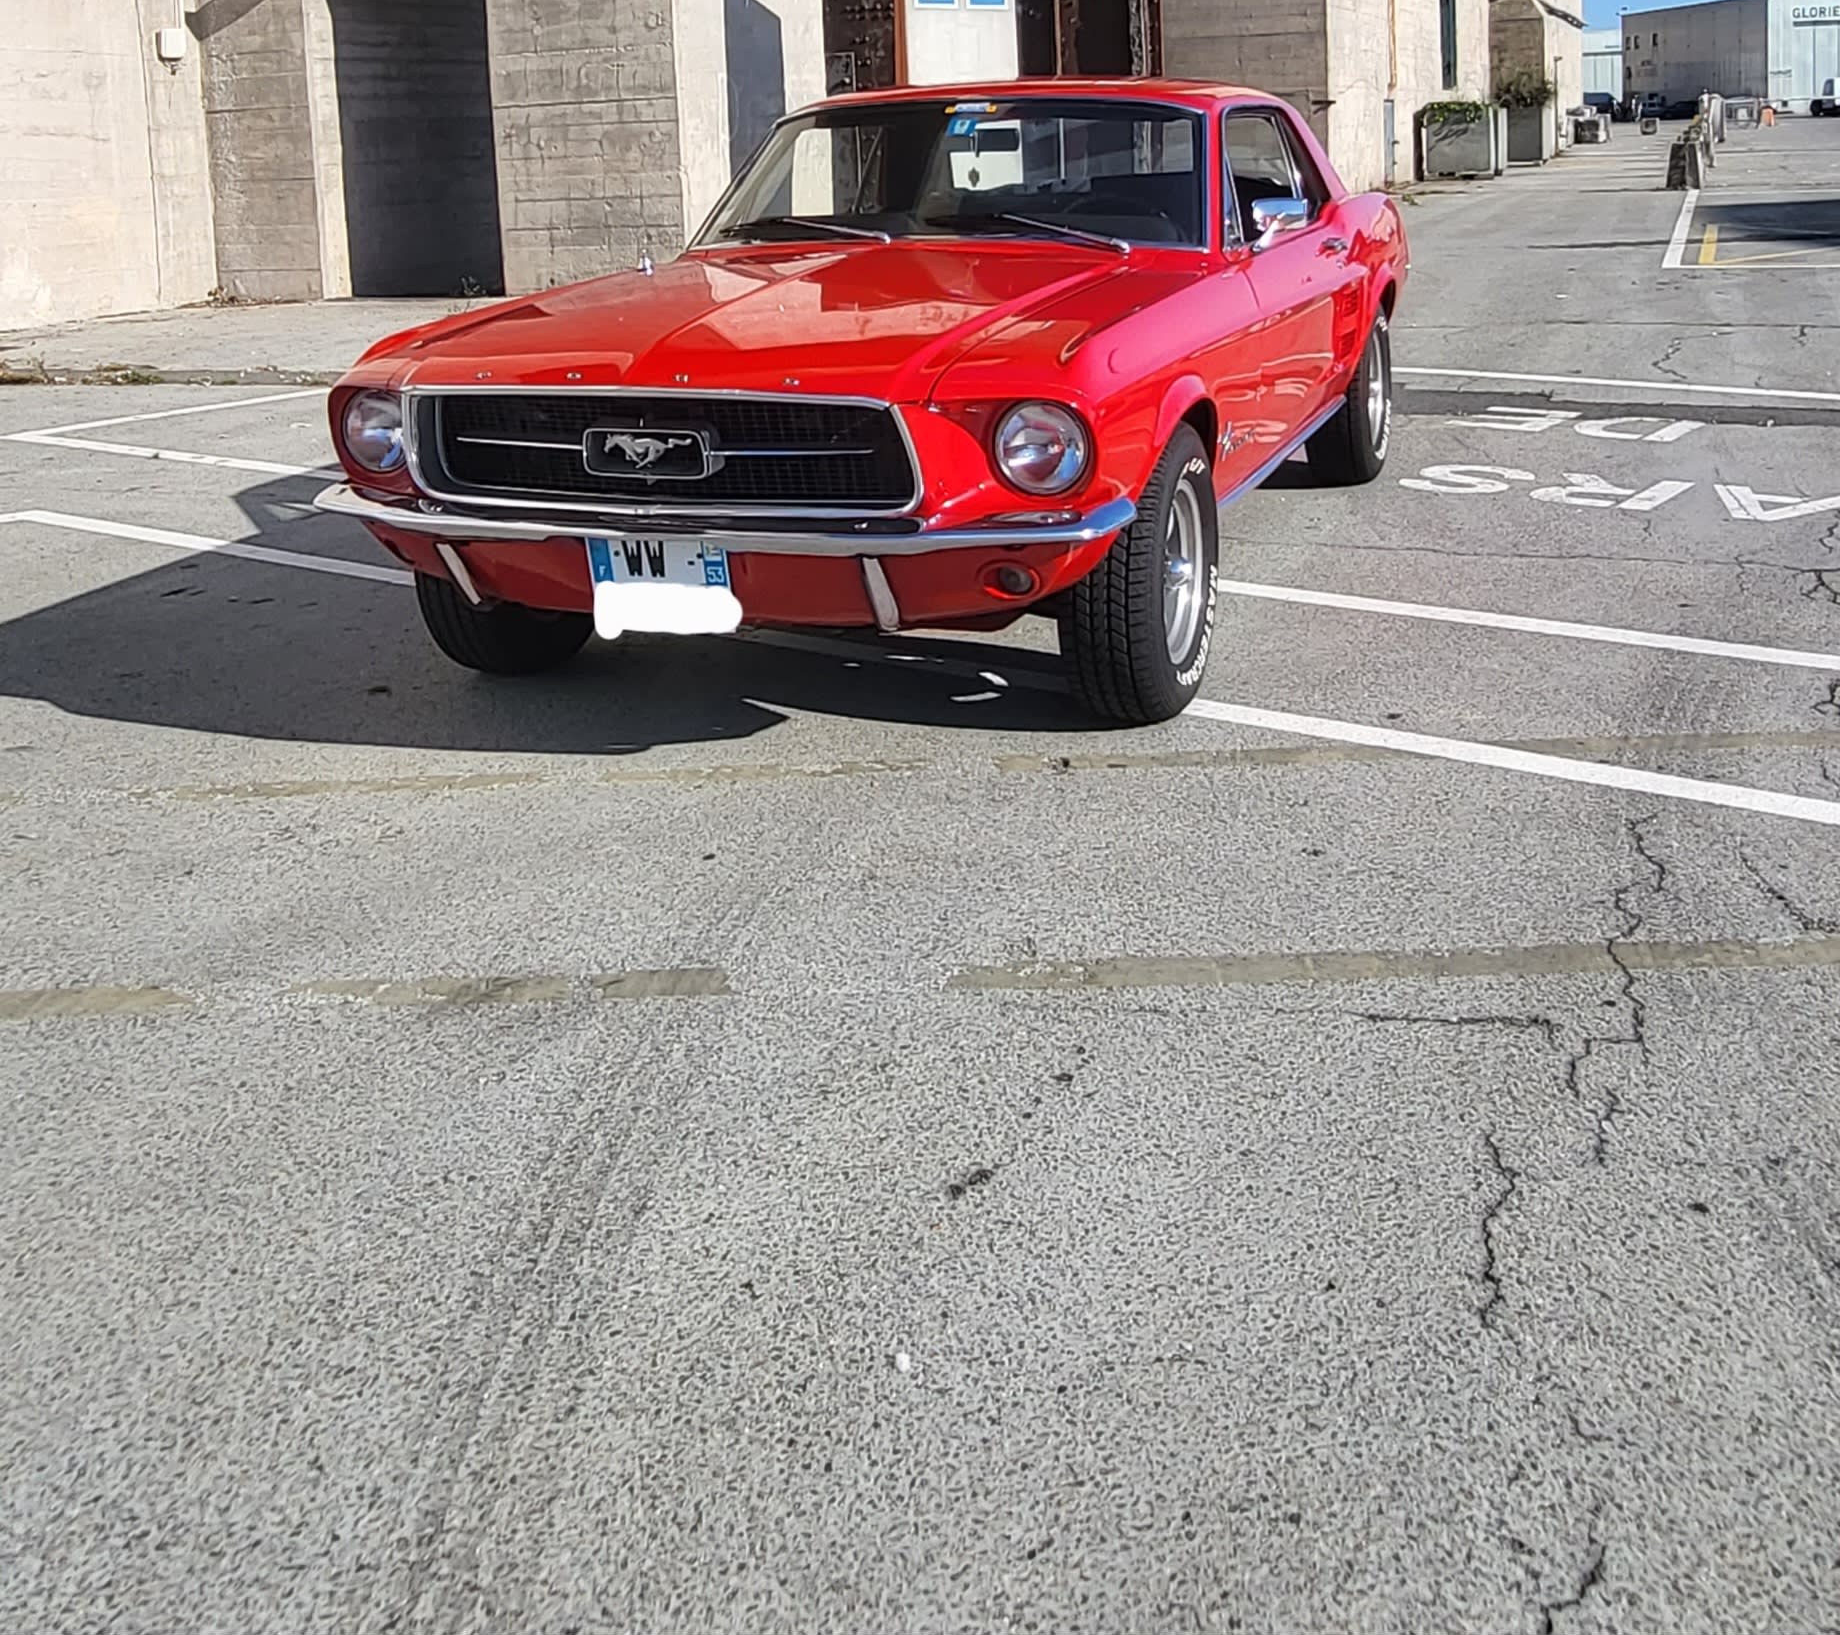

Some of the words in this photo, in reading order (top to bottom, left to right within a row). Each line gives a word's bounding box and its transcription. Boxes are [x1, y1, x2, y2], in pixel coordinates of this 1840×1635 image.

[1792, 6, 1840, 18] GLORIE
[1444, 405, 1706, 443] DE
[599, 565, 607, 577] F
[706, 566, 725, 583] 53
